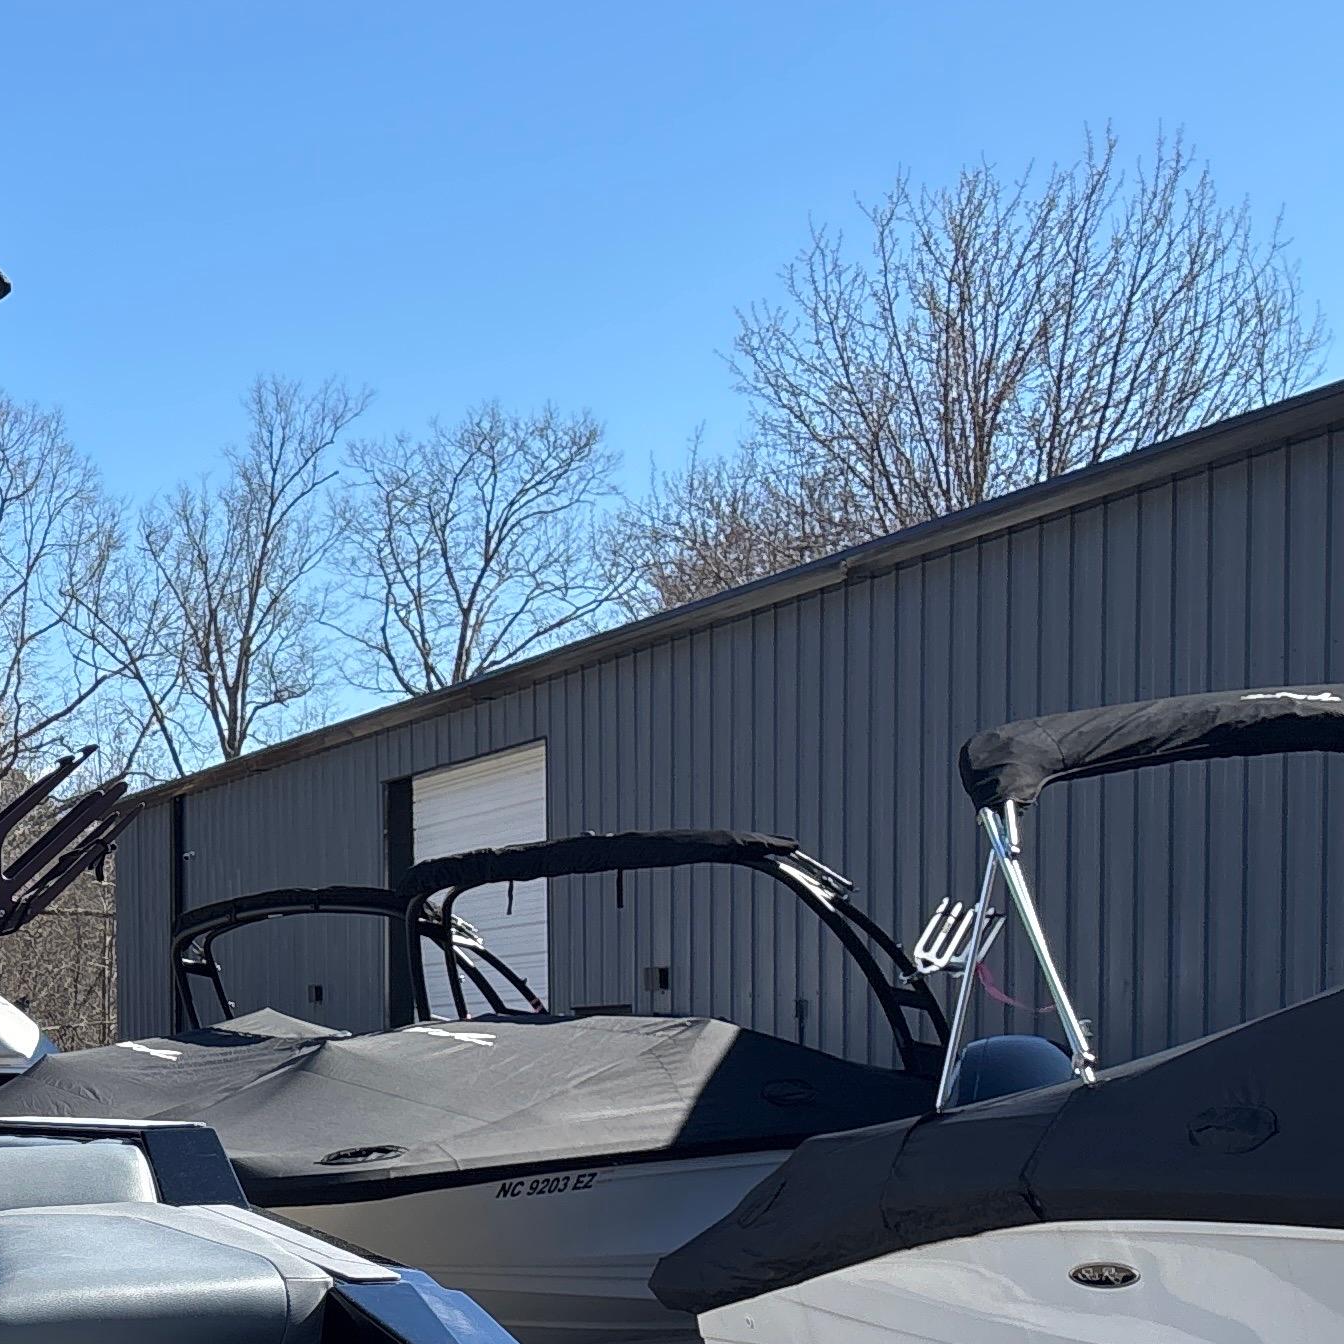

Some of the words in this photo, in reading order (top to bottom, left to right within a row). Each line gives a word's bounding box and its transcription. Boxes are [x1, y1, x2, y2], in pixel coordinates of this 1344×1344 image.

[496, 1181, 523, 1198] NC
[526, 1176, 570, 1196] 9203
[572, 1172, 597, 1190] EZ
